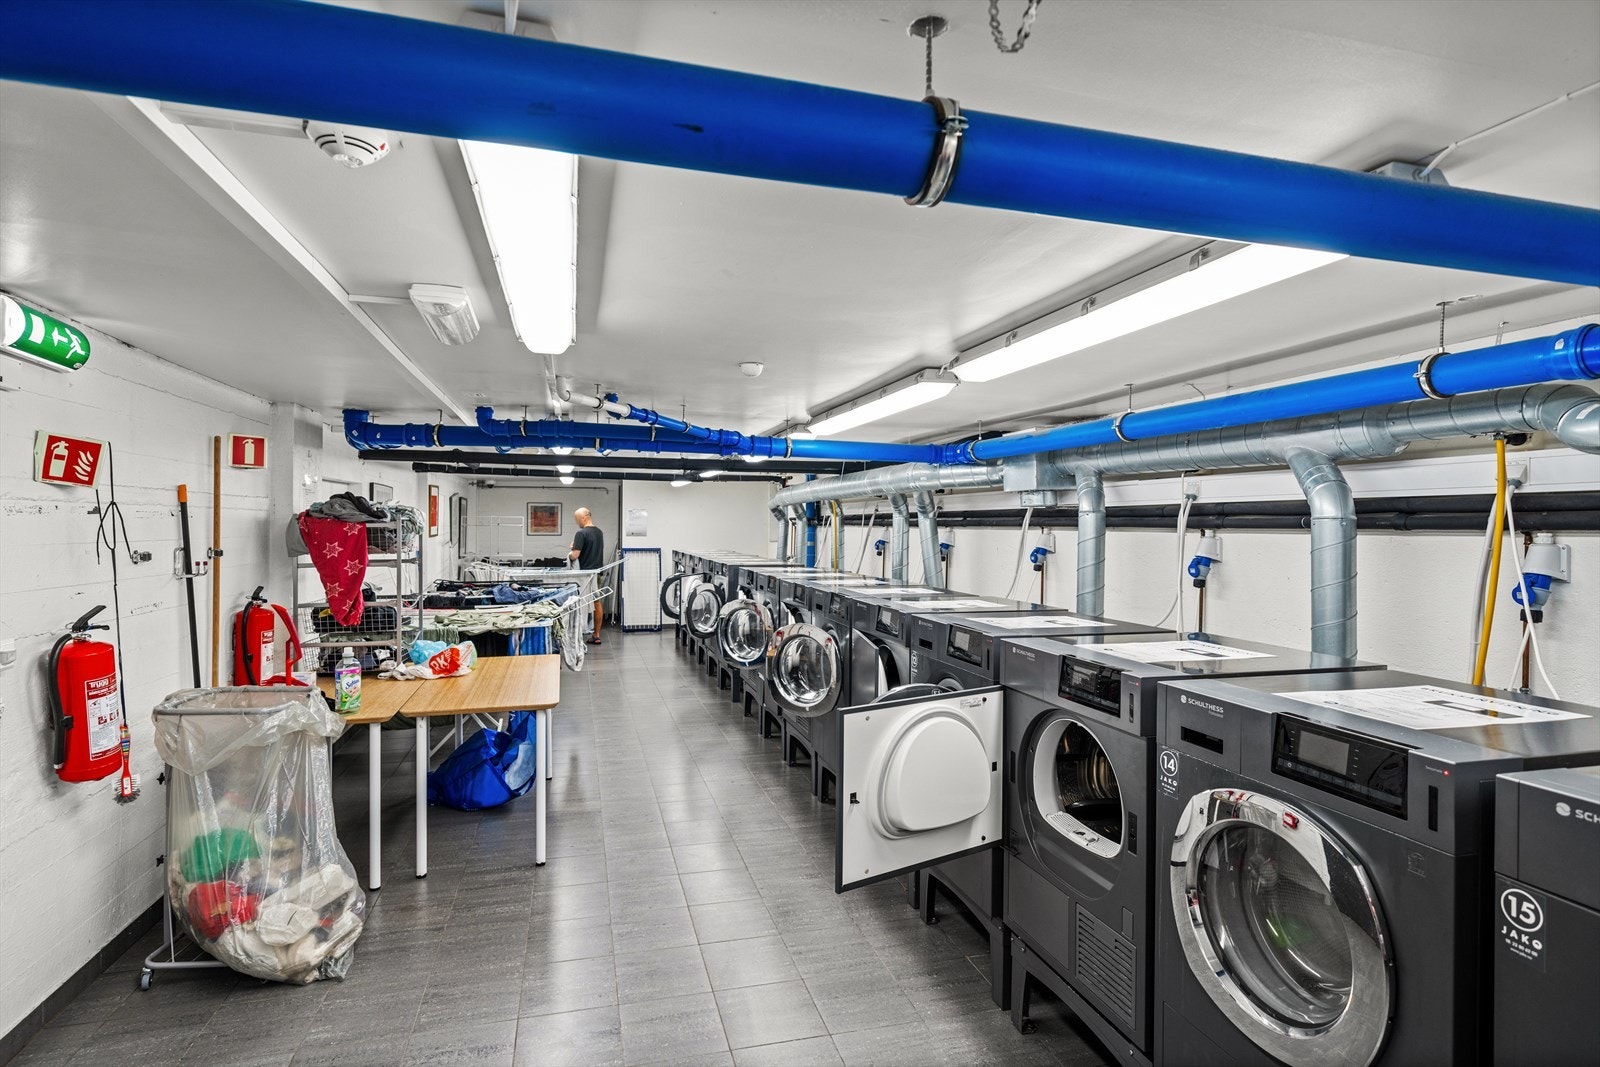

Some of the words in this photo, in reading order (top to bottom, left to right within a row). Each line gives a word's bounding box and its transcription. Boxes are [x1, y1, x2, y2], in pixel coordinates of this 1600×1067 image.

[1187, 697, 1224, 713] SCHULTHESS
[1163, 755, 1176, 772] 14
[1160, 774, 1178, 787] JAKO
[1507, 894, 1537, 925] 15
[1501, 925, 1543, 951] JAKO
